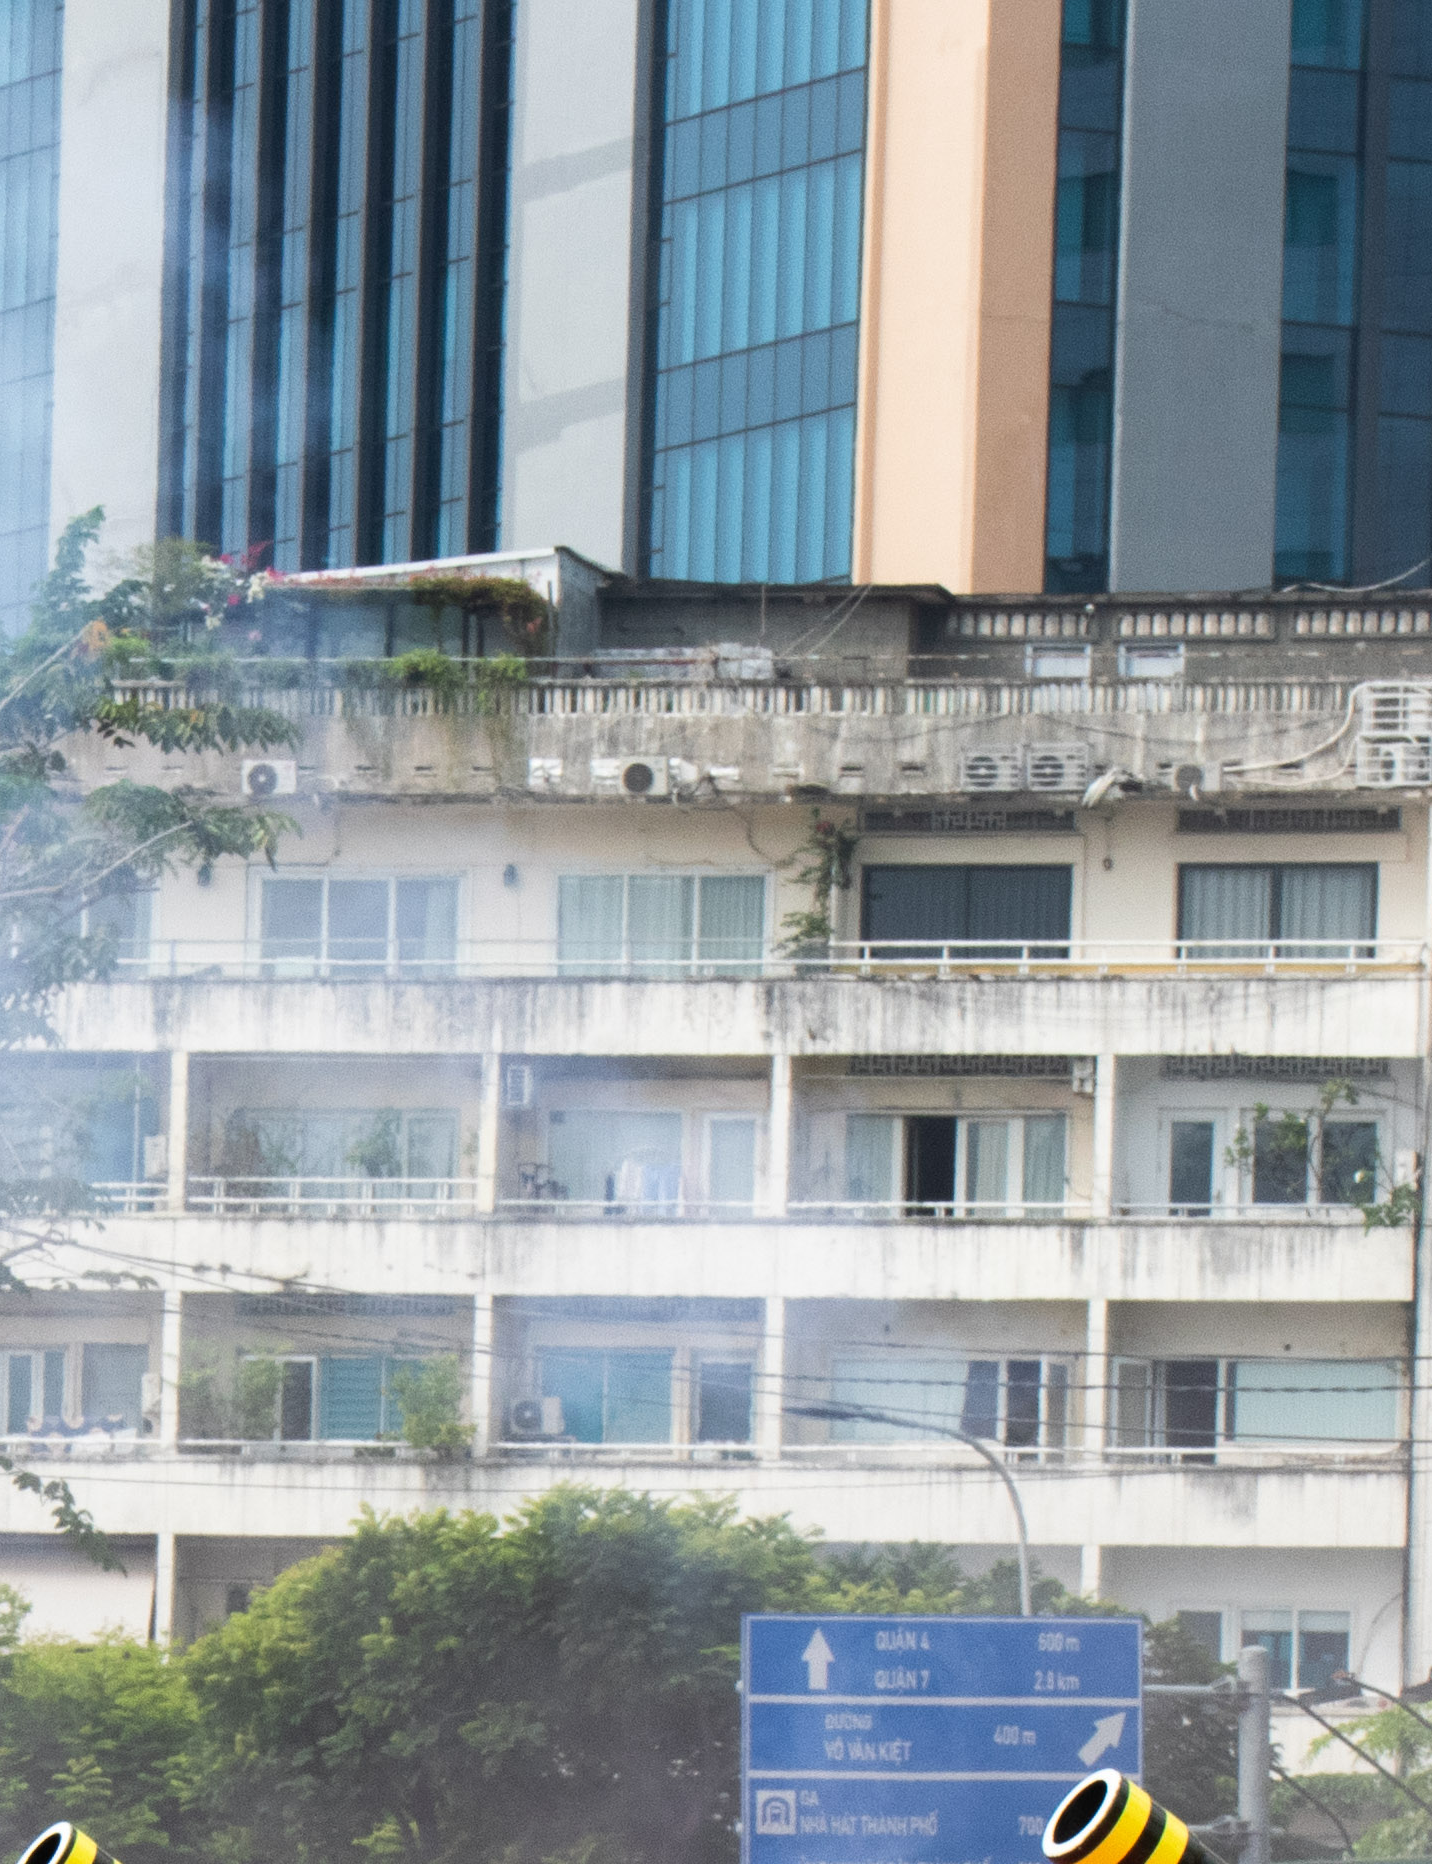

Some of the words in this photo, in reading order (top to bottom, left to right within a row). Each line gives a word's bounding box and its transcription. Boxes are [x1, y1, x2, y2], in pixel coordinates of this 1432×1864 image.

[875, 1627, 917, 1655] QUẬN
[920, 1631, 931, 1650] 4
[1065, 1636, 1080, 1651] m
[874, 1665, 917, 1694] QUẬN
[920, 1669, 931, 1689] 7
[1057, 1672, 1080, 1690] km
